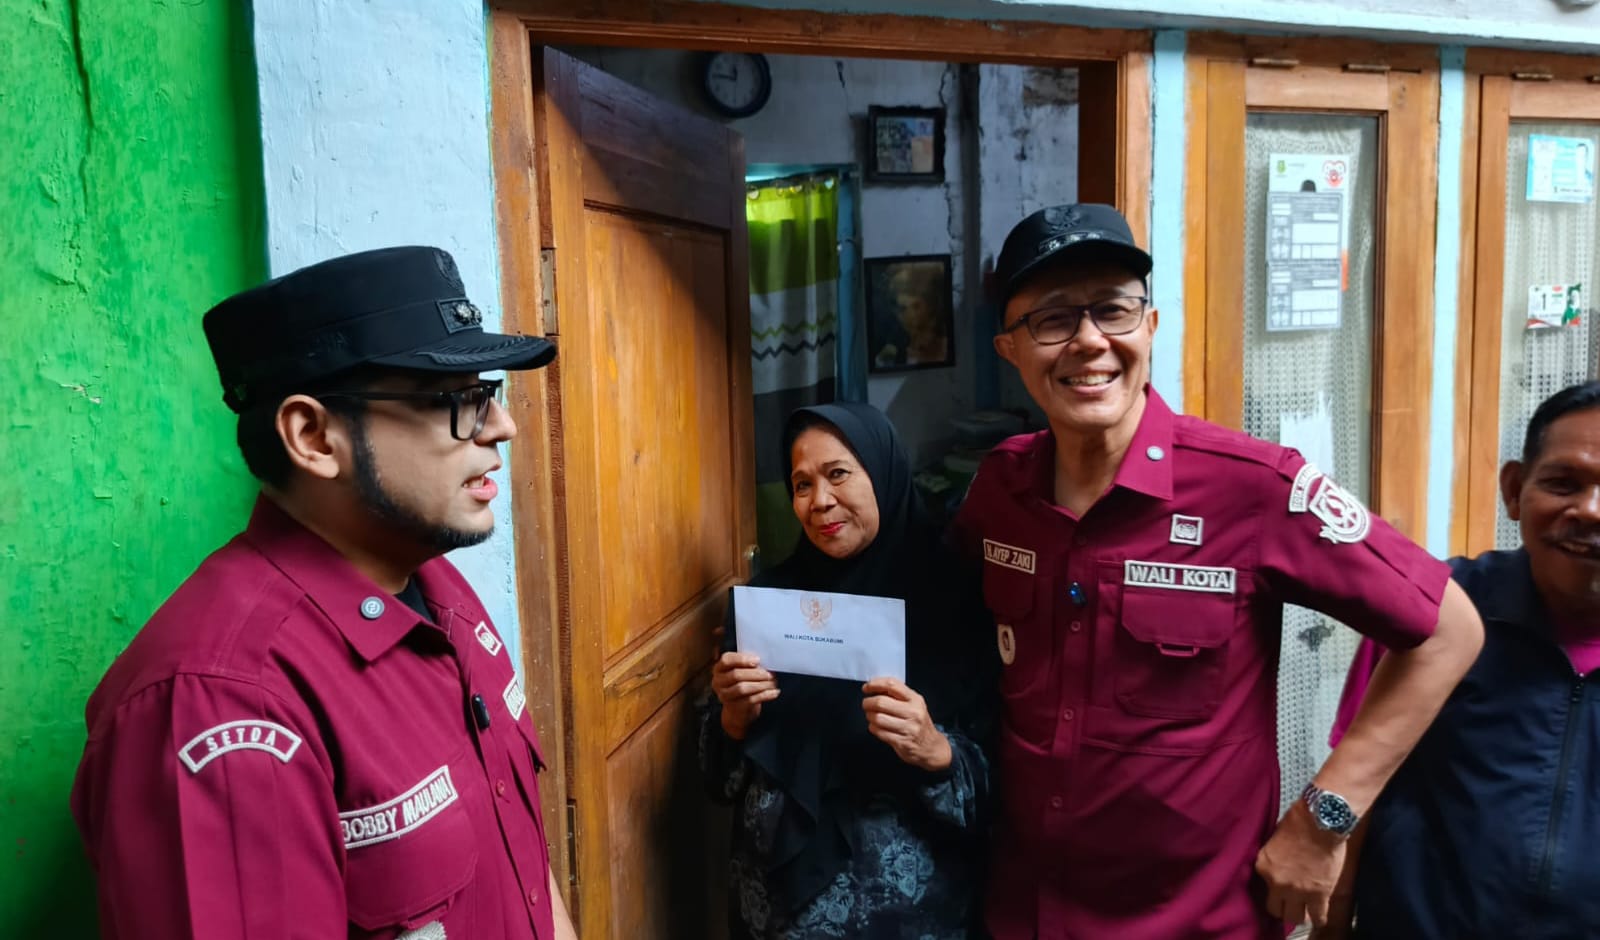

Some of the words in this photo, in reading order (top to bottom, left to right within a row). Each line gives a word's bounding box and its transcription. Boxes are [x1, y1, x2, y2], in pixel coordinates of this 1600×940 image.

[1130, 565, 1176, 584] WALI
[1182, 569, 1230, 588] KOTA
[205, 727, 277, 752] SETDA
[340, 807, 398, 842] BOBBY
[402, 775, 452, 827] MAULANA
